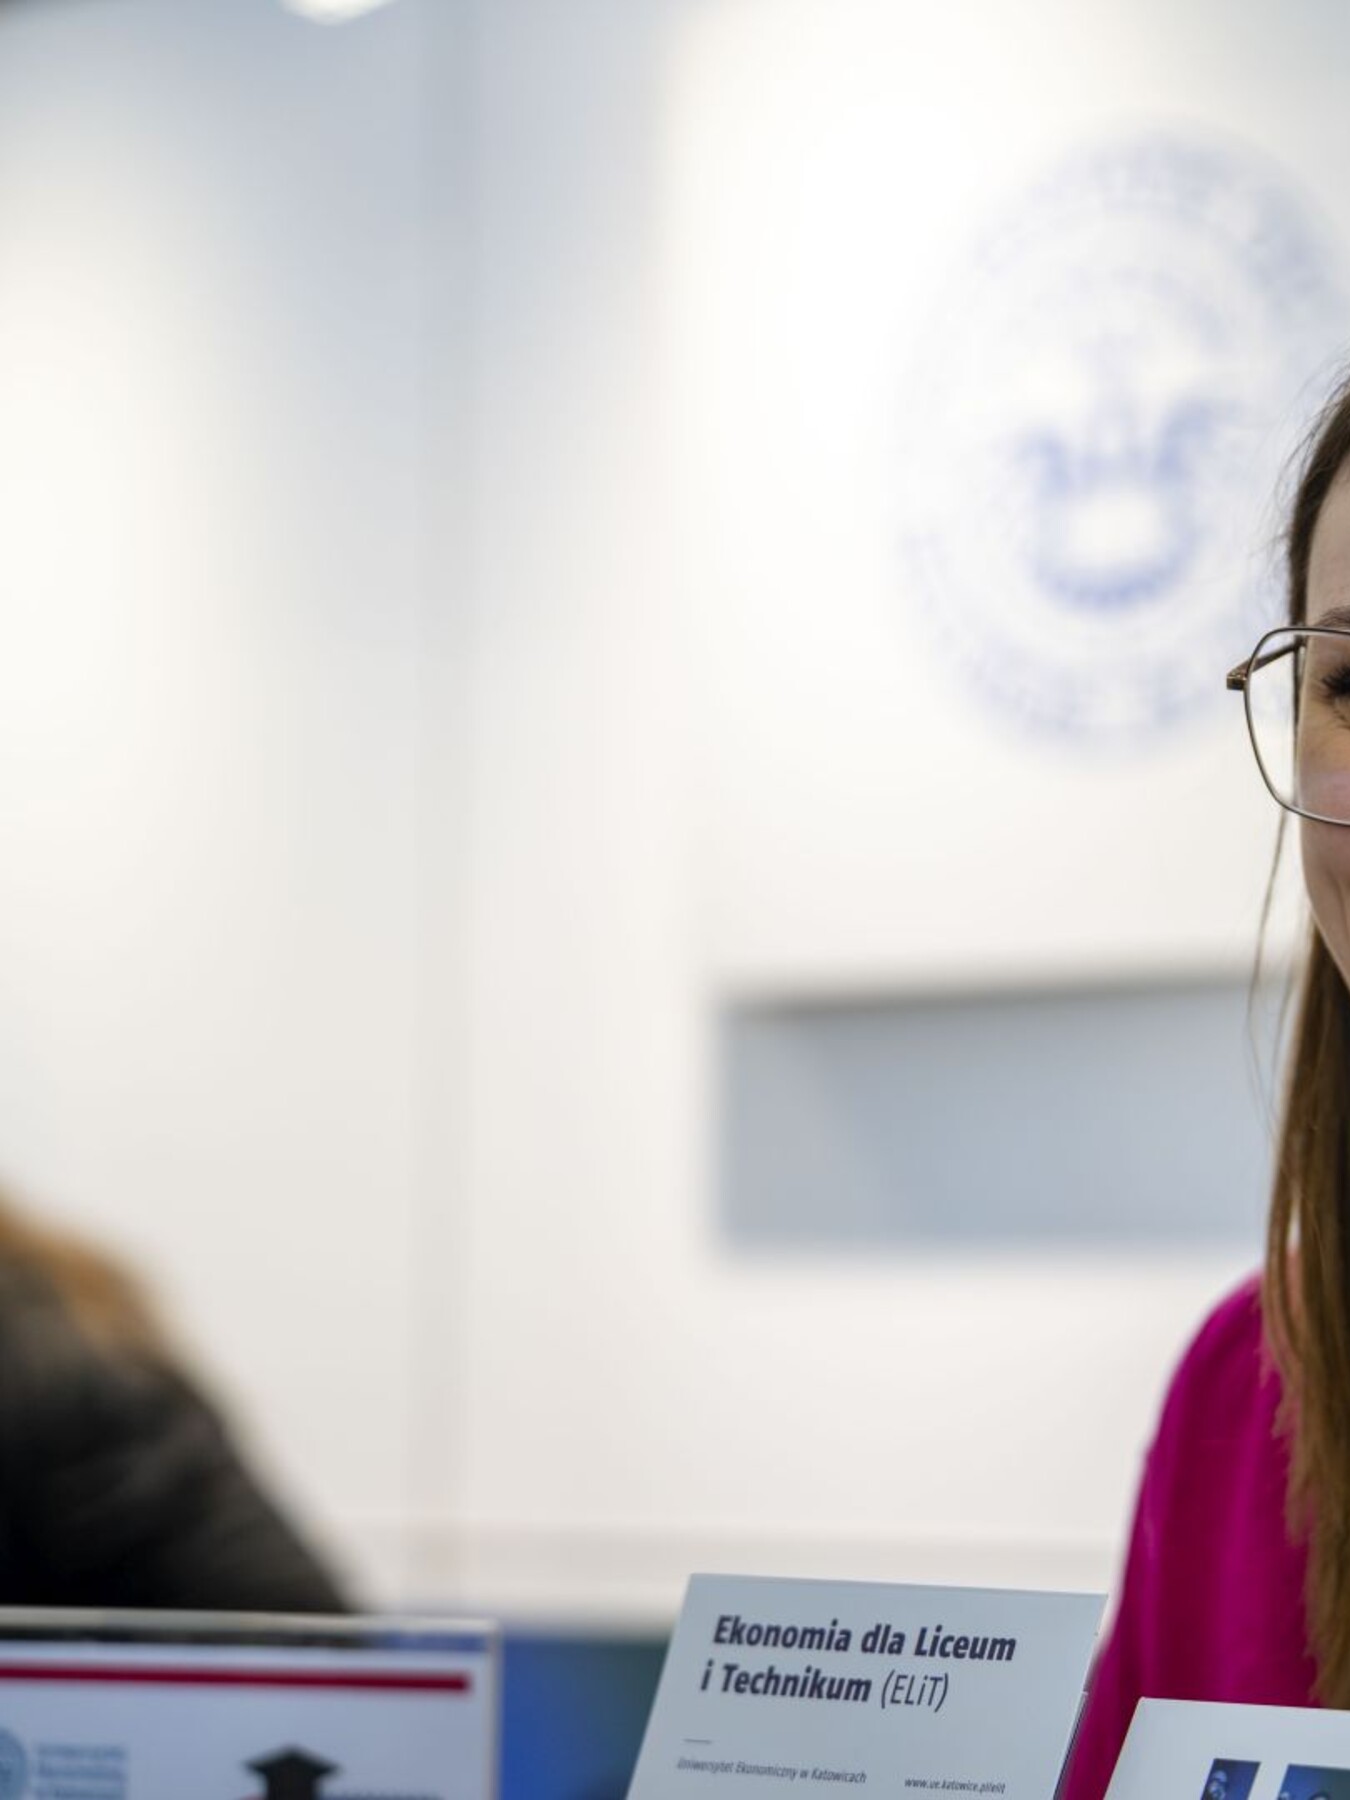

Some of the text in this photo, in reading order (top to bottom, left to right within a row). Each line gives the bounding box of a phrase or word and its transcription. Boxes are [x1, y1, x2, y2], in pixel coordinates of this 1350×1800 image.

[713, 1615, 1017, 1661] Ekonomia dla Liceum
[700, 1659, 949, 1713] i Technikum (ELiT)
[811, 1768, 867, 1784] Katowicach
